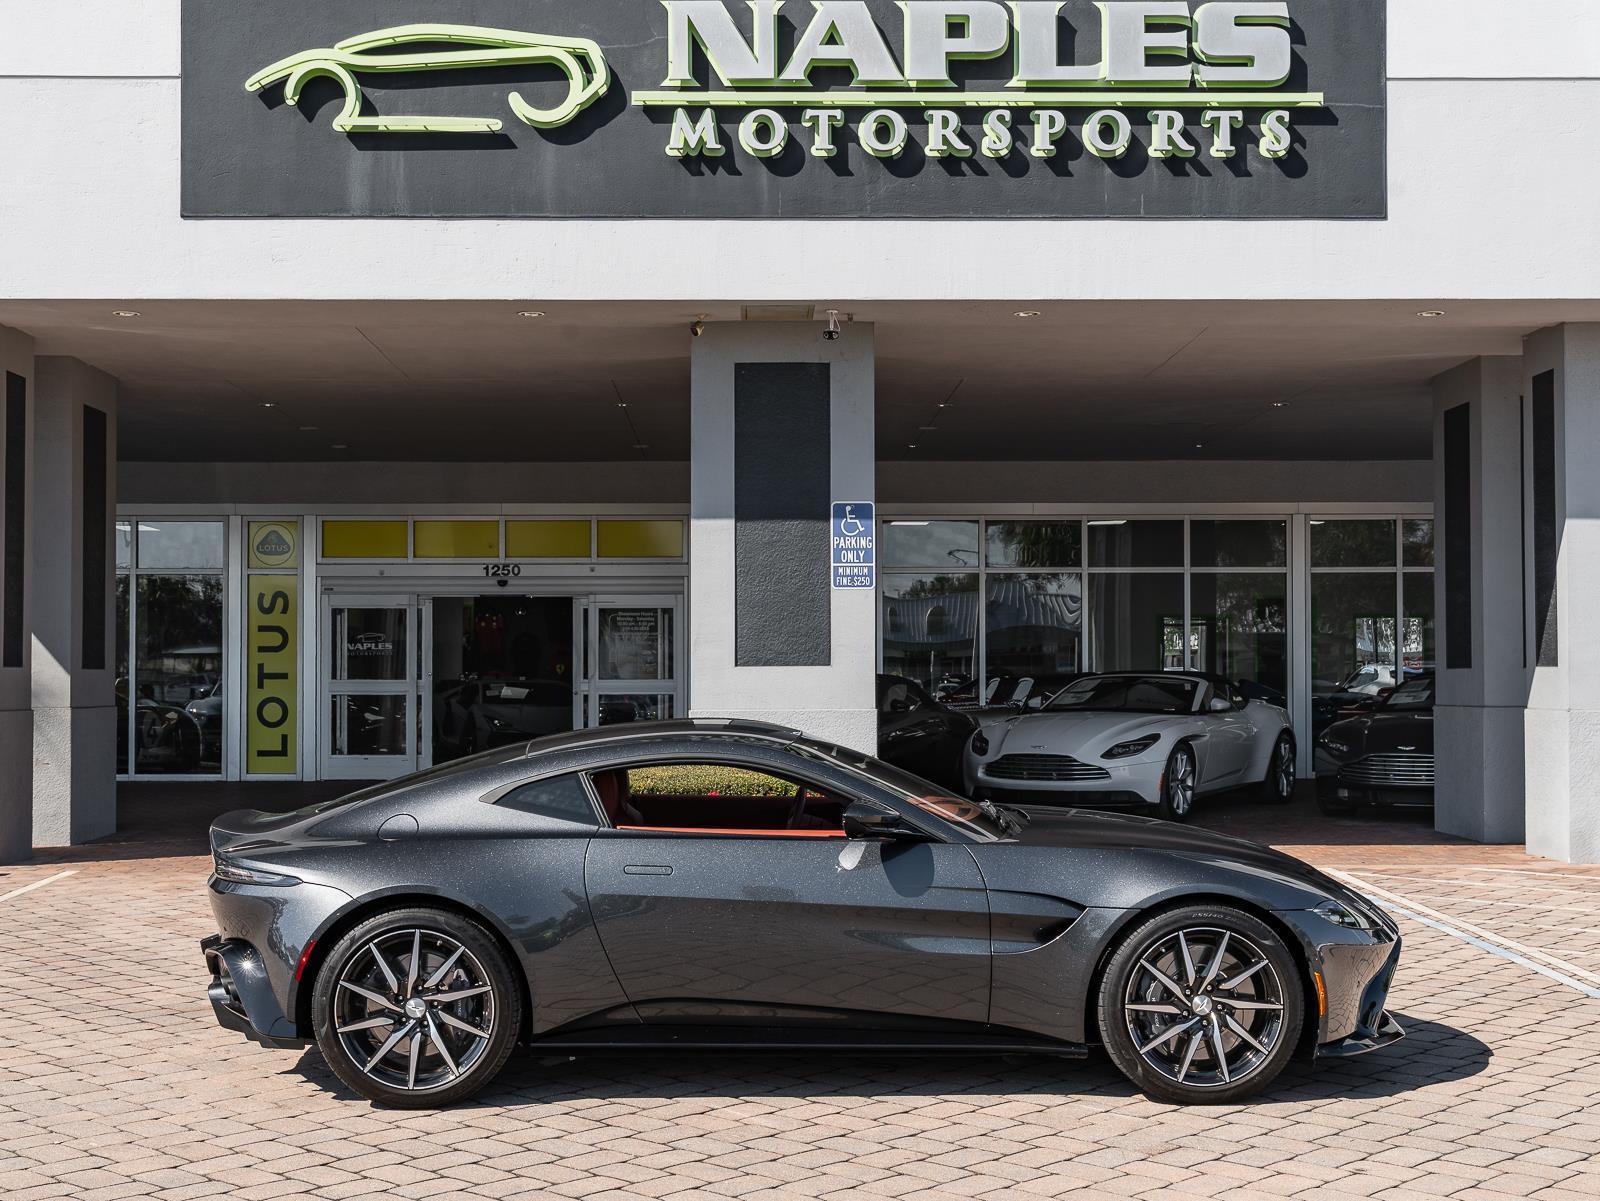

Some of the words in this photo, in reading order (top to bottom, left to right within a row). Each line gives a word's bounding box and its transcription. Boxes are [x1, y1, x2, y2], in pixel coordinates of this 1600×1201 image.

[660, 0, 1292, 88] NAPLES
[665, 107, 1292, 158] MOTORSPORTS
[259, 544, 289, 552] LOTUS
[834, 536, 872, 548] PARKING
[841, 550, 865, 562] ONLY
[483, 563, 521, 577] 1250
[838, 566, 868, 576] MINIMUM
[836, 576, 852, 586] FINE
[853, 576, 870, 587] $250
[347, 642, 393, 650] NAPLES
[256, 590, 289, 758] LOTUS
